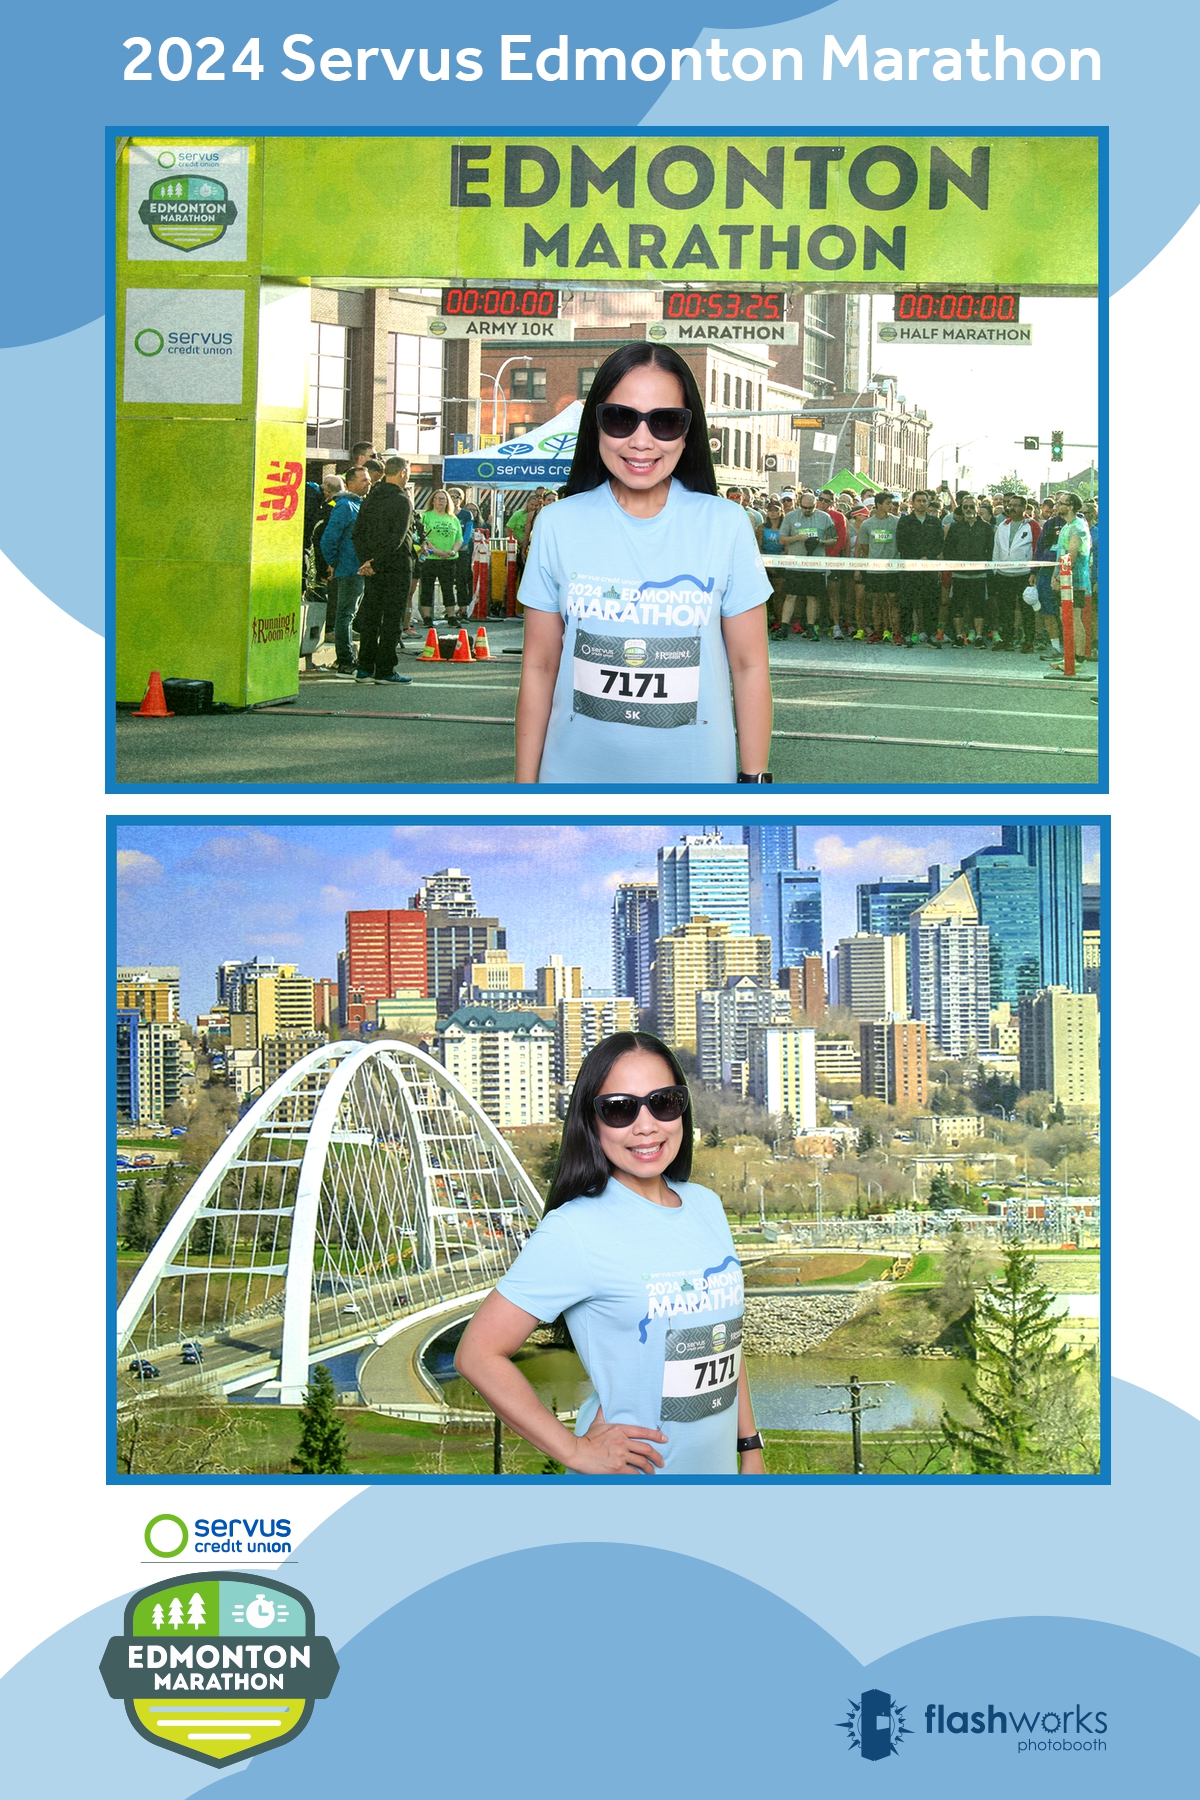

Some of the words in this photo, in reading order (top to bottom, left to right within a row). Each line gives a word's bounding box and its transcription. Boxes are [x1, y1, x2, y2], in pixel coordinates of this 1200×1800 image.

[178, 152, 220, 161] servus
[449, 144, 991, 211] EDMONTON
[149, 202, 227, 214] EDMONTON
[160, 214, 216, 222] MARATHON
[523, 222, 907, 271] MARATHON
[465, 321, 518, 335] ARMY
[521, 322, 554, 337] 10K
[678, 325, 785, 340] MARATHON
[900, 327, 939, 340] HALF
[942, 328, 1031, 341] MARATHON
[168, 331, 233, 345] servus
[167, 345, 200, 355] credit
[203, 347, 233, 355] union
[496, 465, 545, 475] servus
[548, 465, 570, 475] cre
[567, 582, 602, 597] 2024
[621, 587, 713, 605] EDMONTON
[566, 595, 712, 627] MARATHON
[257, 613, 290, 638] Running
[600, 669, 668, 698] 7171
[625, 710, 641, 720] 5K
[645, 1281, 681, 1297] 2024
[692, 1269, 744, 1291] EDMONT
[648, 1284, 744, 1319] MARATHO
[694, 1353, 735, 1390] 7171
[711, 1397, 722, 1409] 5K
